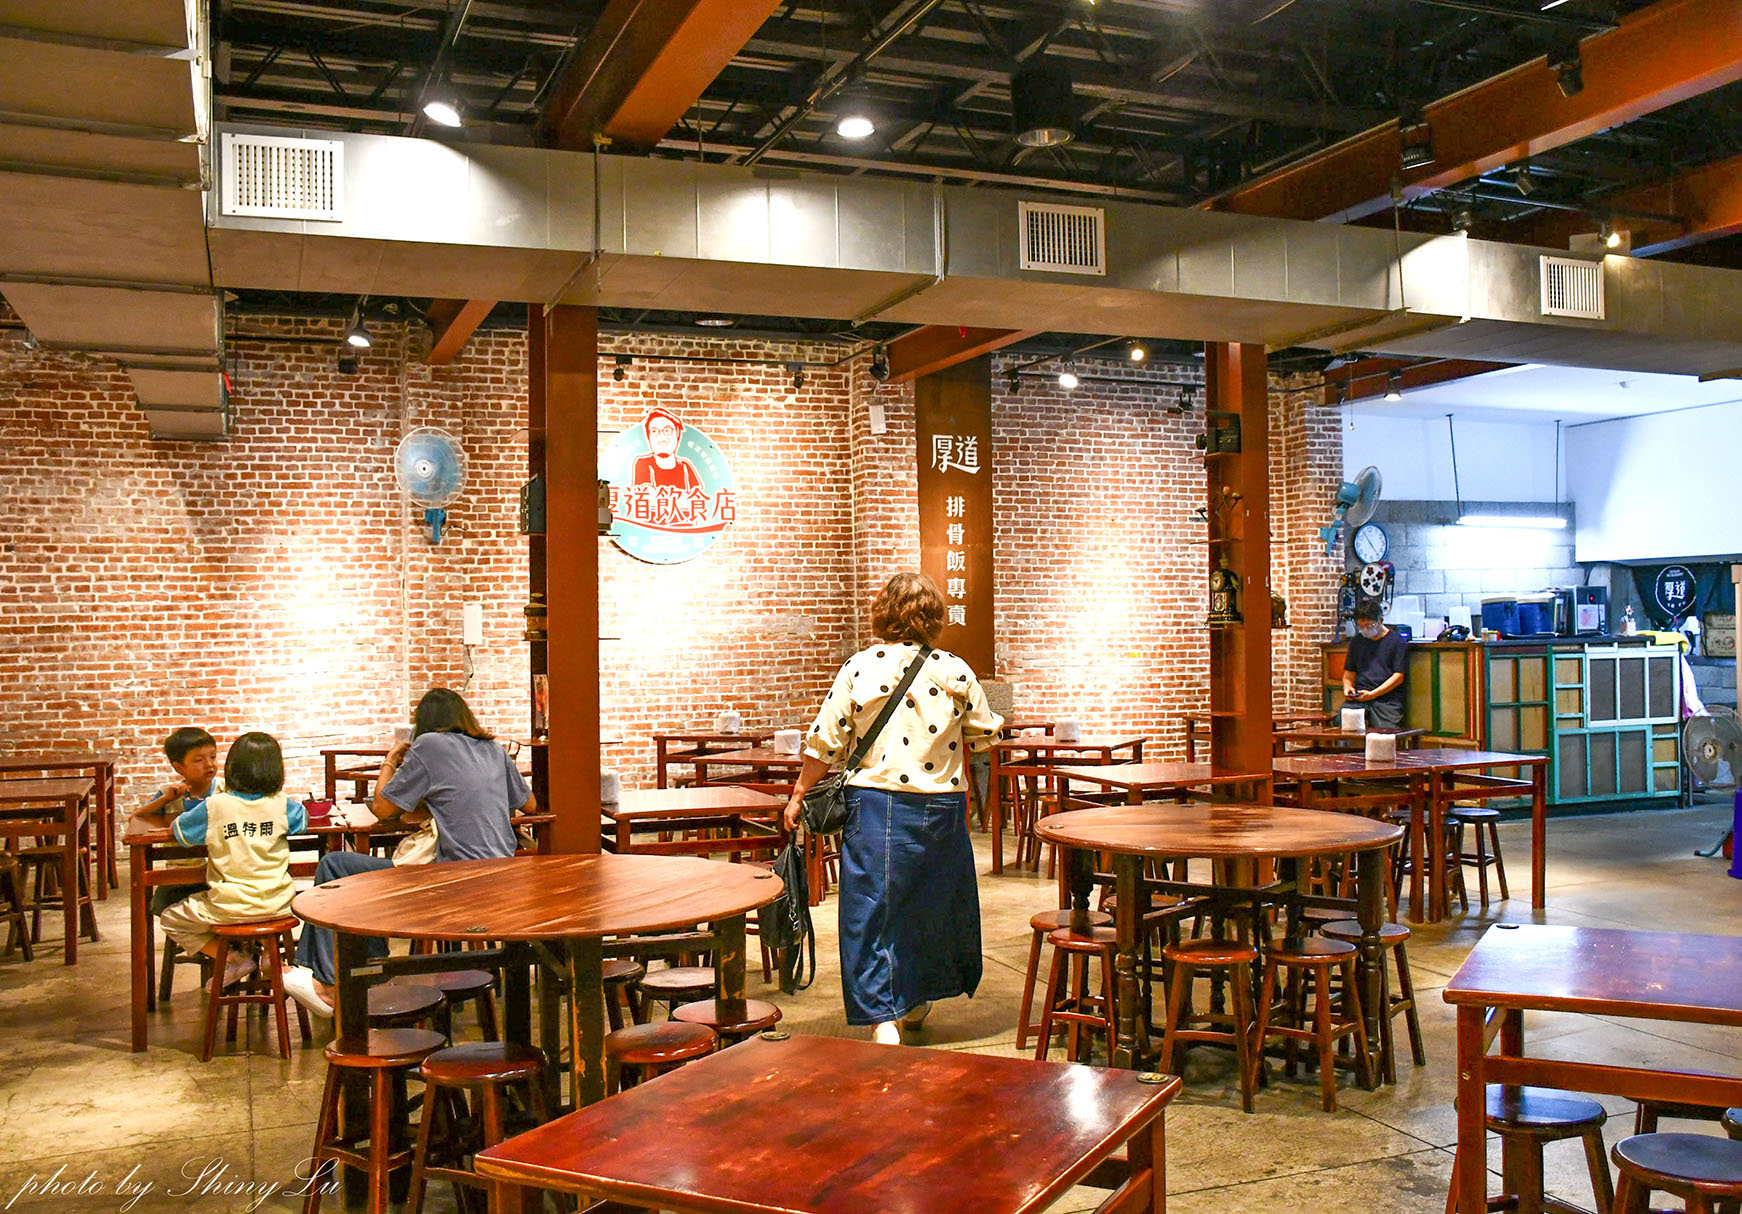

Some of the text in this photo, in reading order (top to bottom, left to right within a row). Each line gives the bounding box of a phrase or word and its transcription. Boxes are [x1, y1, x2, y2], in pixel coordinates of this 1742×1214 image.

[931, 434, 981, 474] 厚道
[946, 496, 967, 627] 排骨飯專賣
